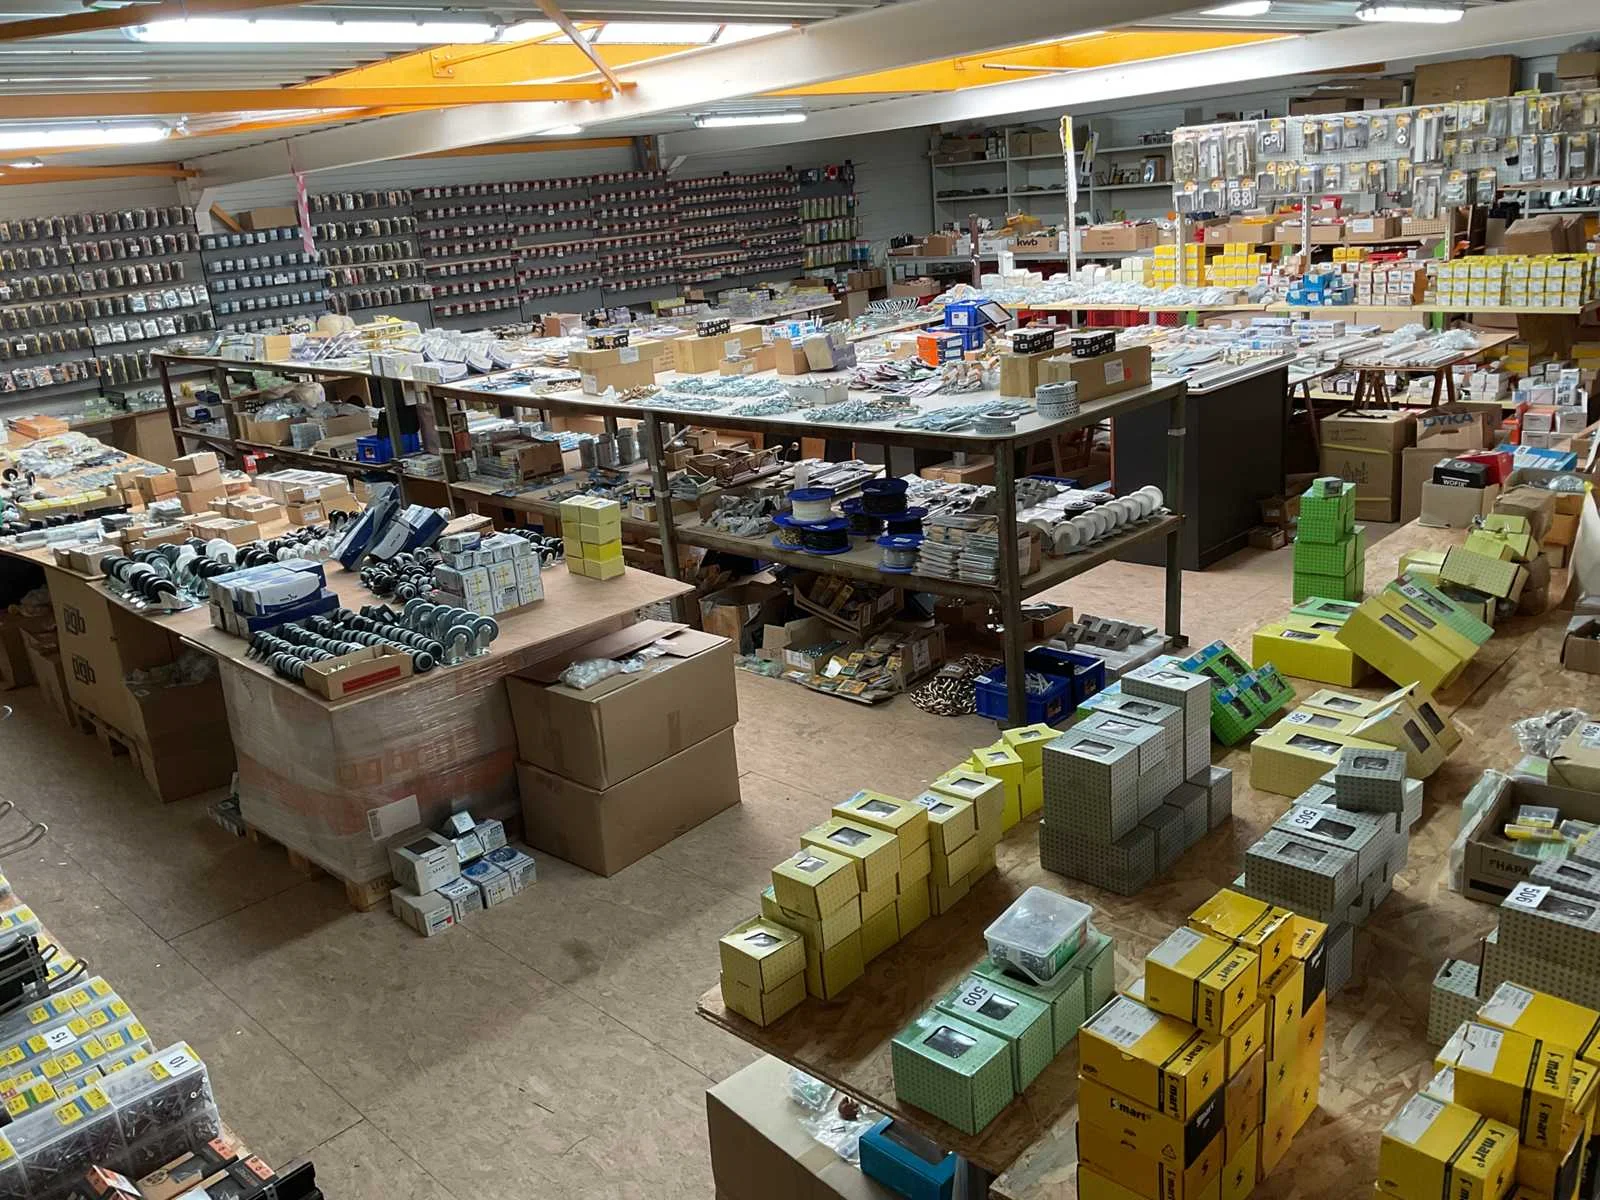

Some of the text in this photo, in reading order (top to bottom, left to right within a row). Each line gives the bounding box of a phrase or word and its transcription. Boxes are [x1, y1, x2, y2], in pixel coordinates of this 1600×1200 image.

[1017, 236, 1038, 246] kwb
[1295, 808, 1317, 825] 505
[1515, 887, 1541, 904] 506
[962, 985, 989, 1006] 509
[51, 1031, 70, 1045] 15
[169, 1055, 188, 1069] 10
